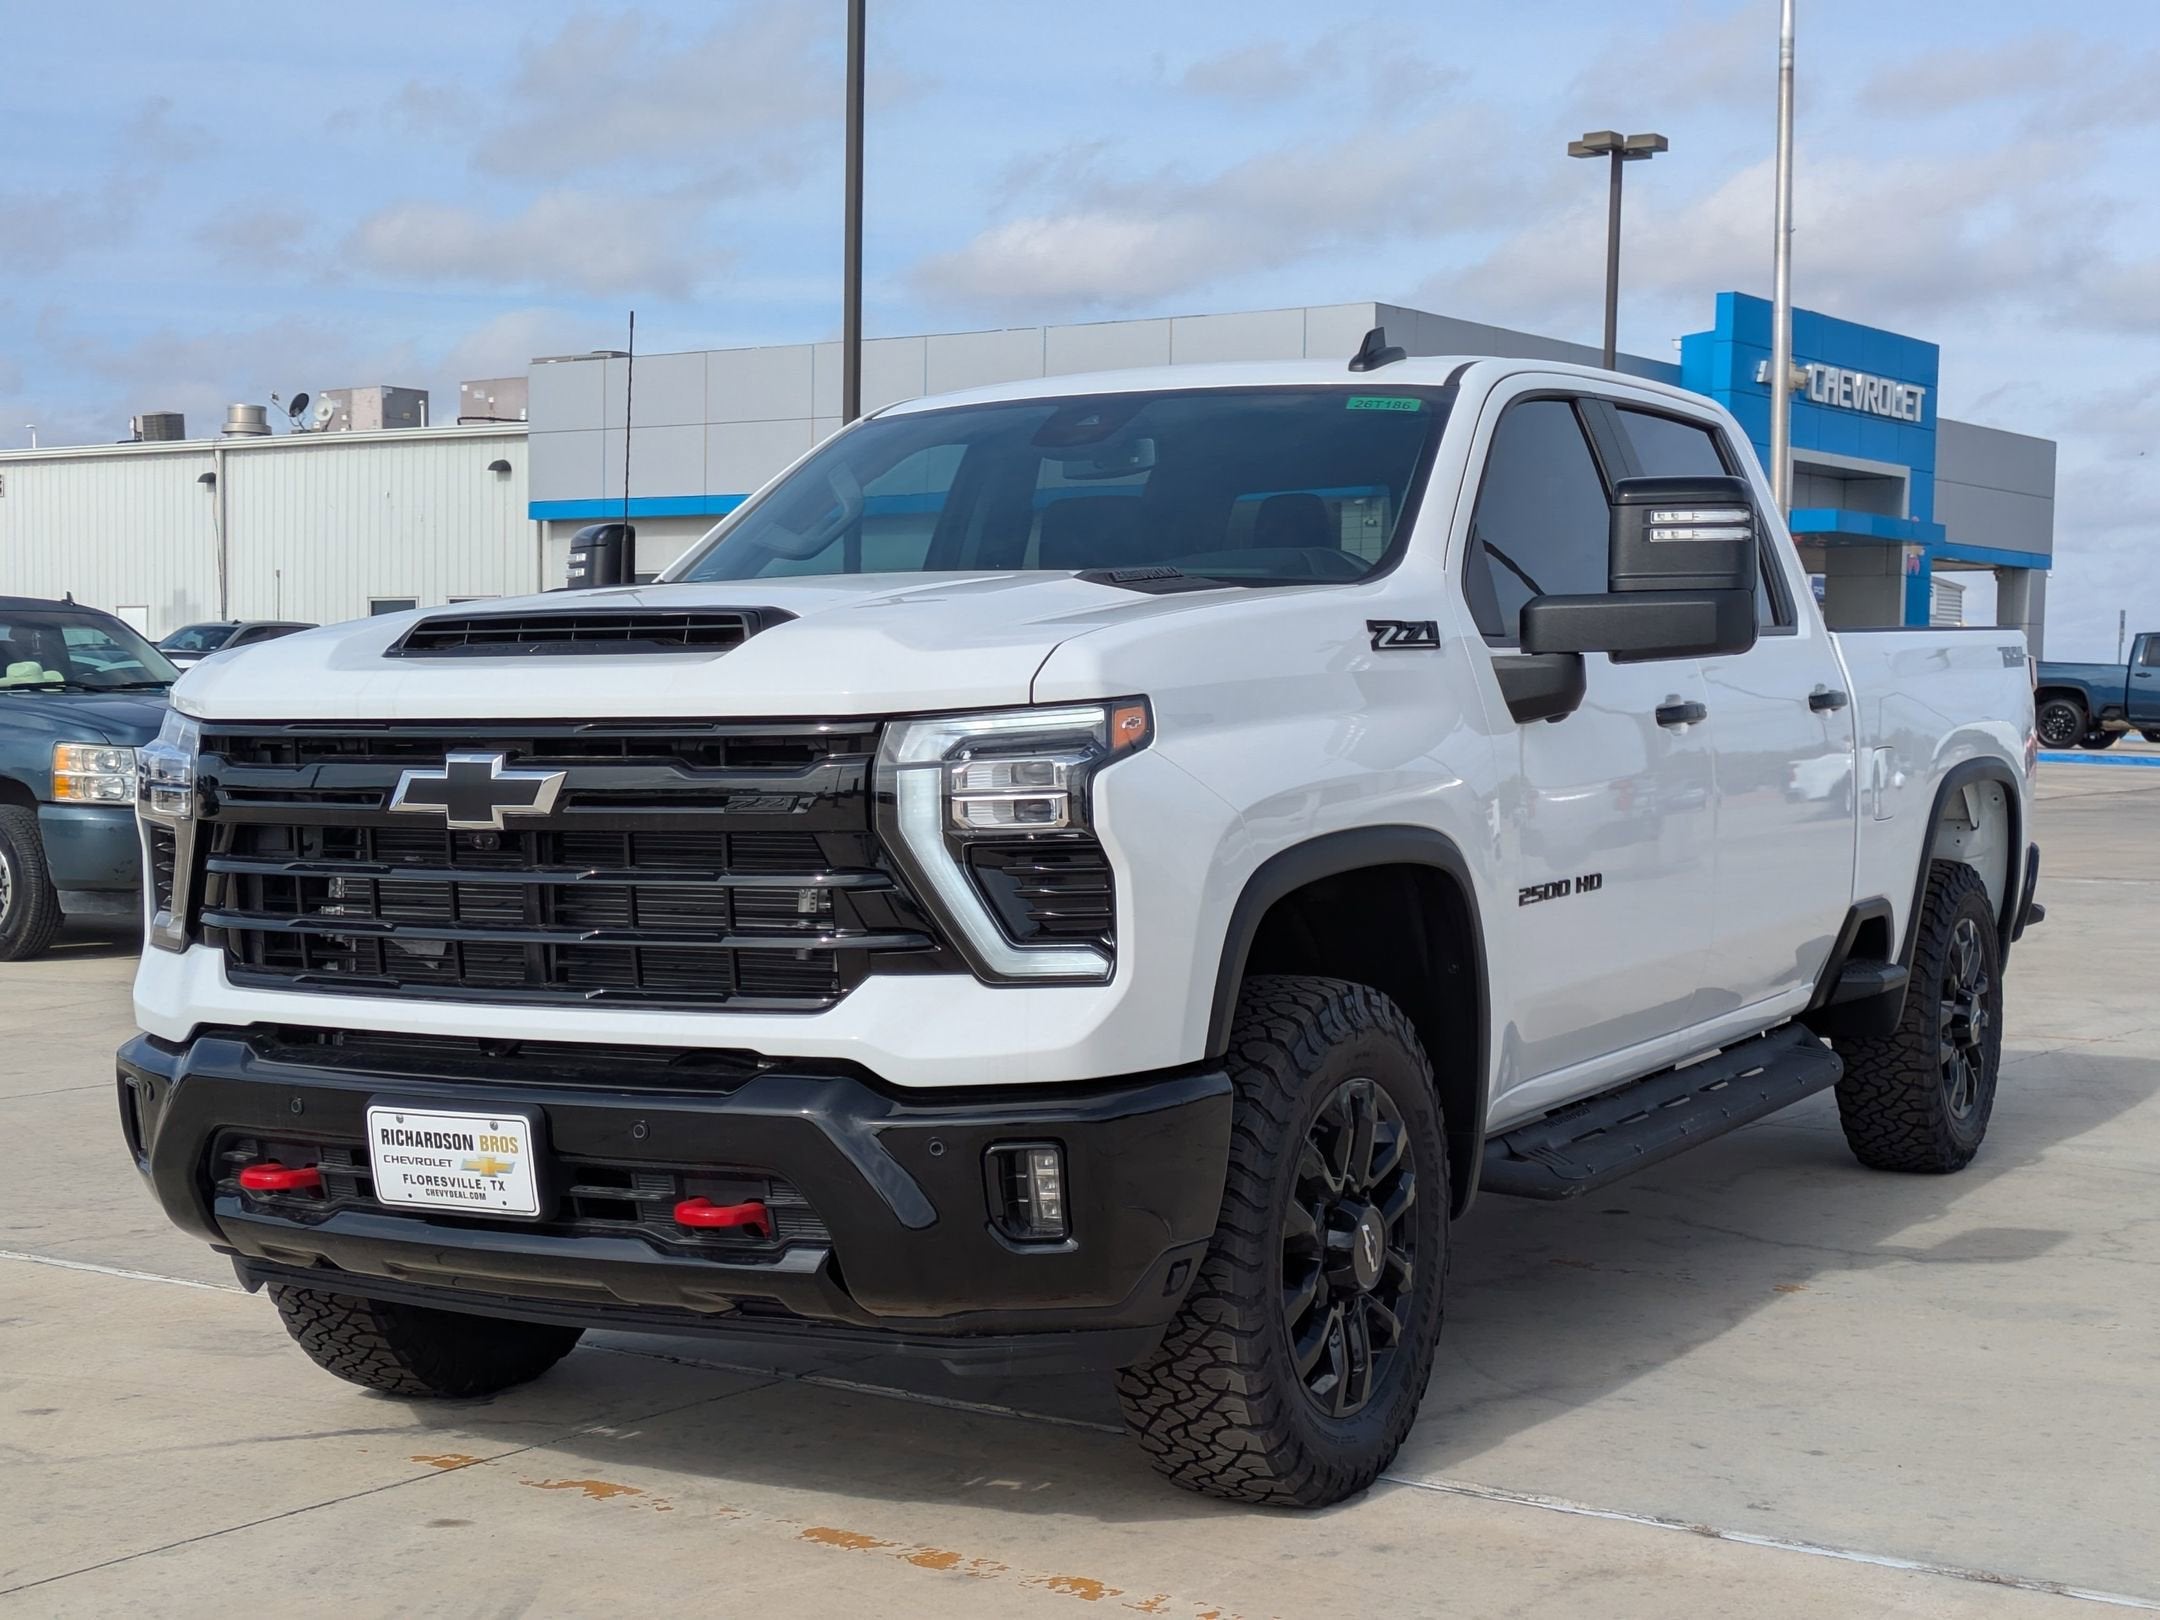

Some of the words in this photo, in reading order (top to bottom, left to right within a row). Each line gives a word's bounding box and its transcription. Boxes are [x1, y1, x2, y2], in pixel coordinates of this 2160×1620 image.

[1806, 363, 1926, 423] CHEVROLET
[1366, 619, 1441, 652] Z71
[1519, 879, 1571, 907] 2500
[1575, 872, 1603, 894] HD
[380, 1128, 474, 1152] RICHARDSON
[479, 1134, 519, 1154] BROS
[383, 1154, 453, 1168] CHEVROLET
[402, 1173, 487, 1191] FLORESVILLE,
[490, 1180, 506, 1191] TX
[425, 1188, 487, 1200] CHEVYDEAL.COM
